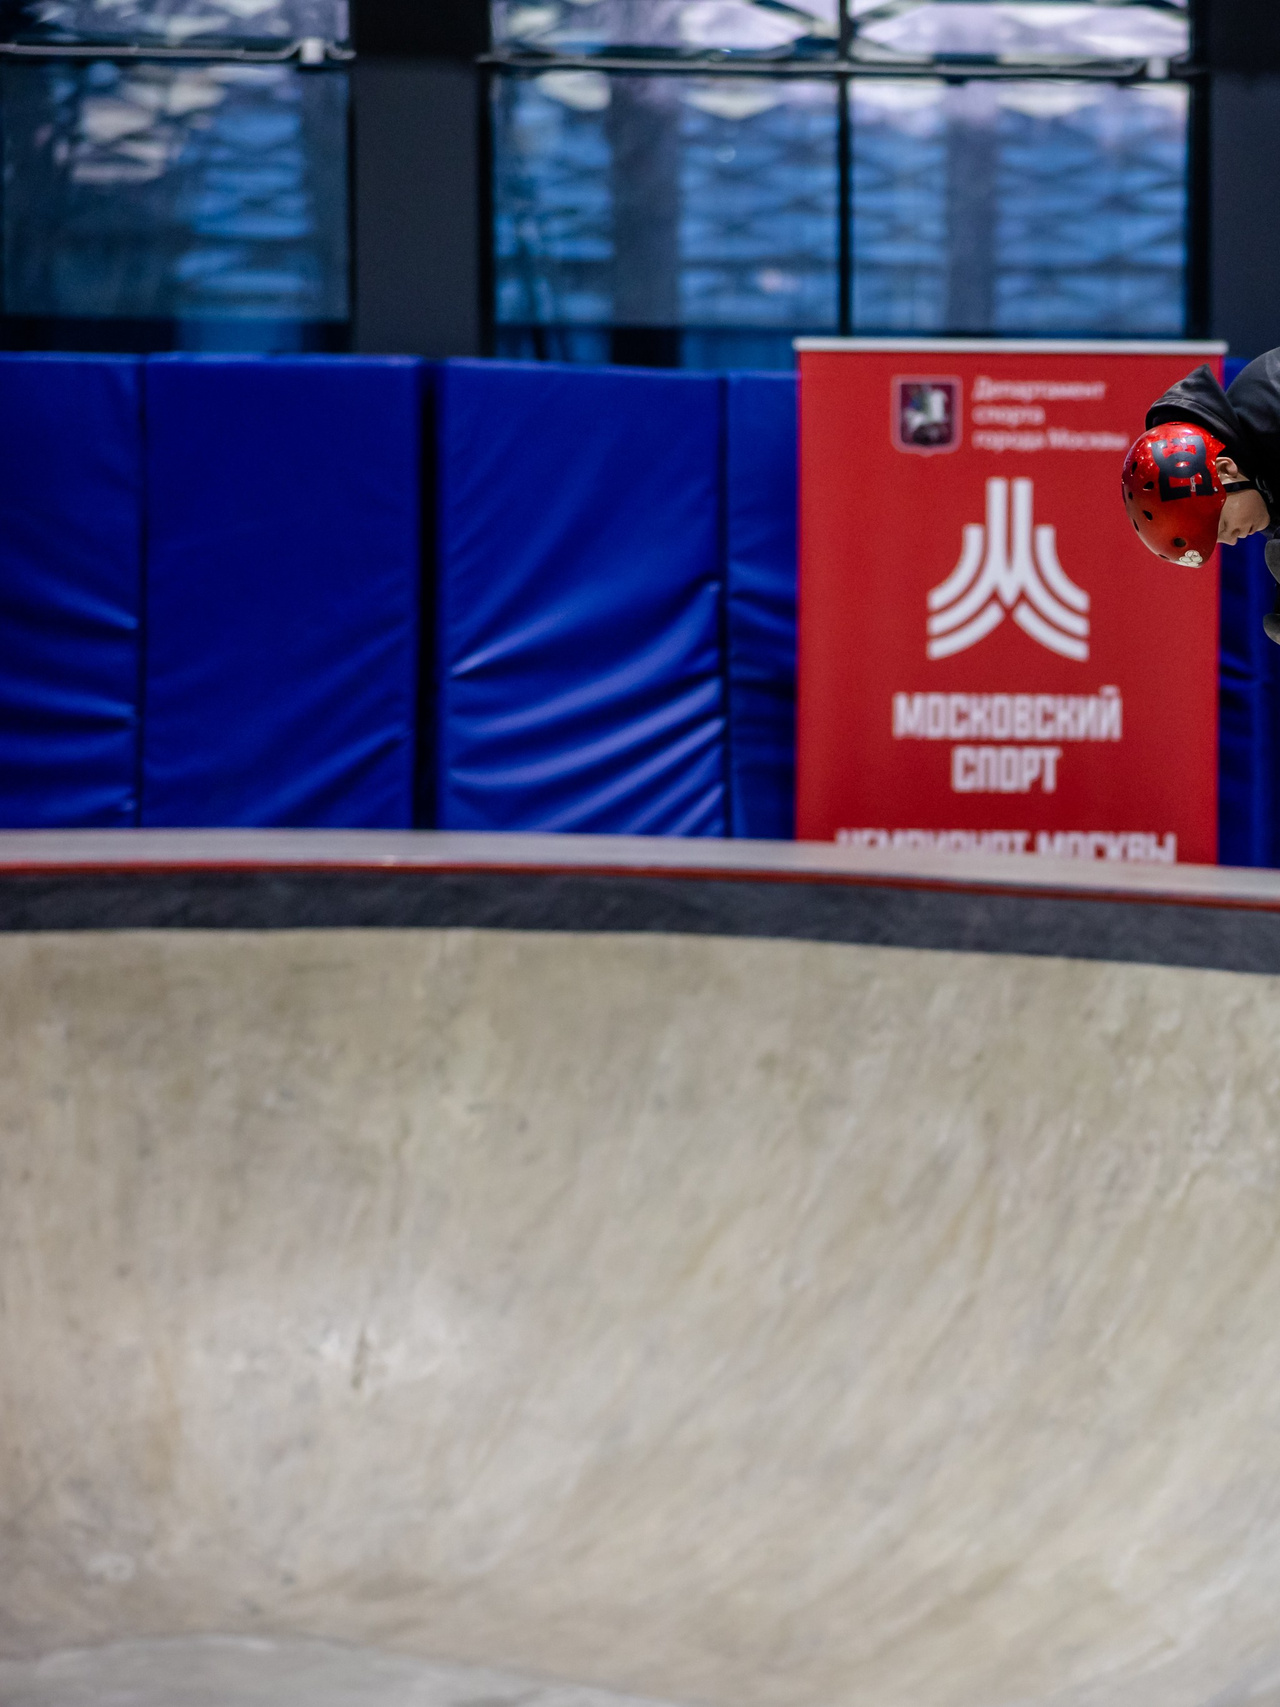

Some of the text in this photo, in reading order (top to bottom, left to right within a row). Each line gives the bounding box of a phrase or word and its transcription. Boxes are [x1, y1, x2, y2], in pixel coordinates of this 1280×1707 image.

[972, 376, 1107, 404] Департамент
[893, 685, 1122, 741] МОСКОВСКИЙ
[952, 745, 1062, 793] СПОРТ
